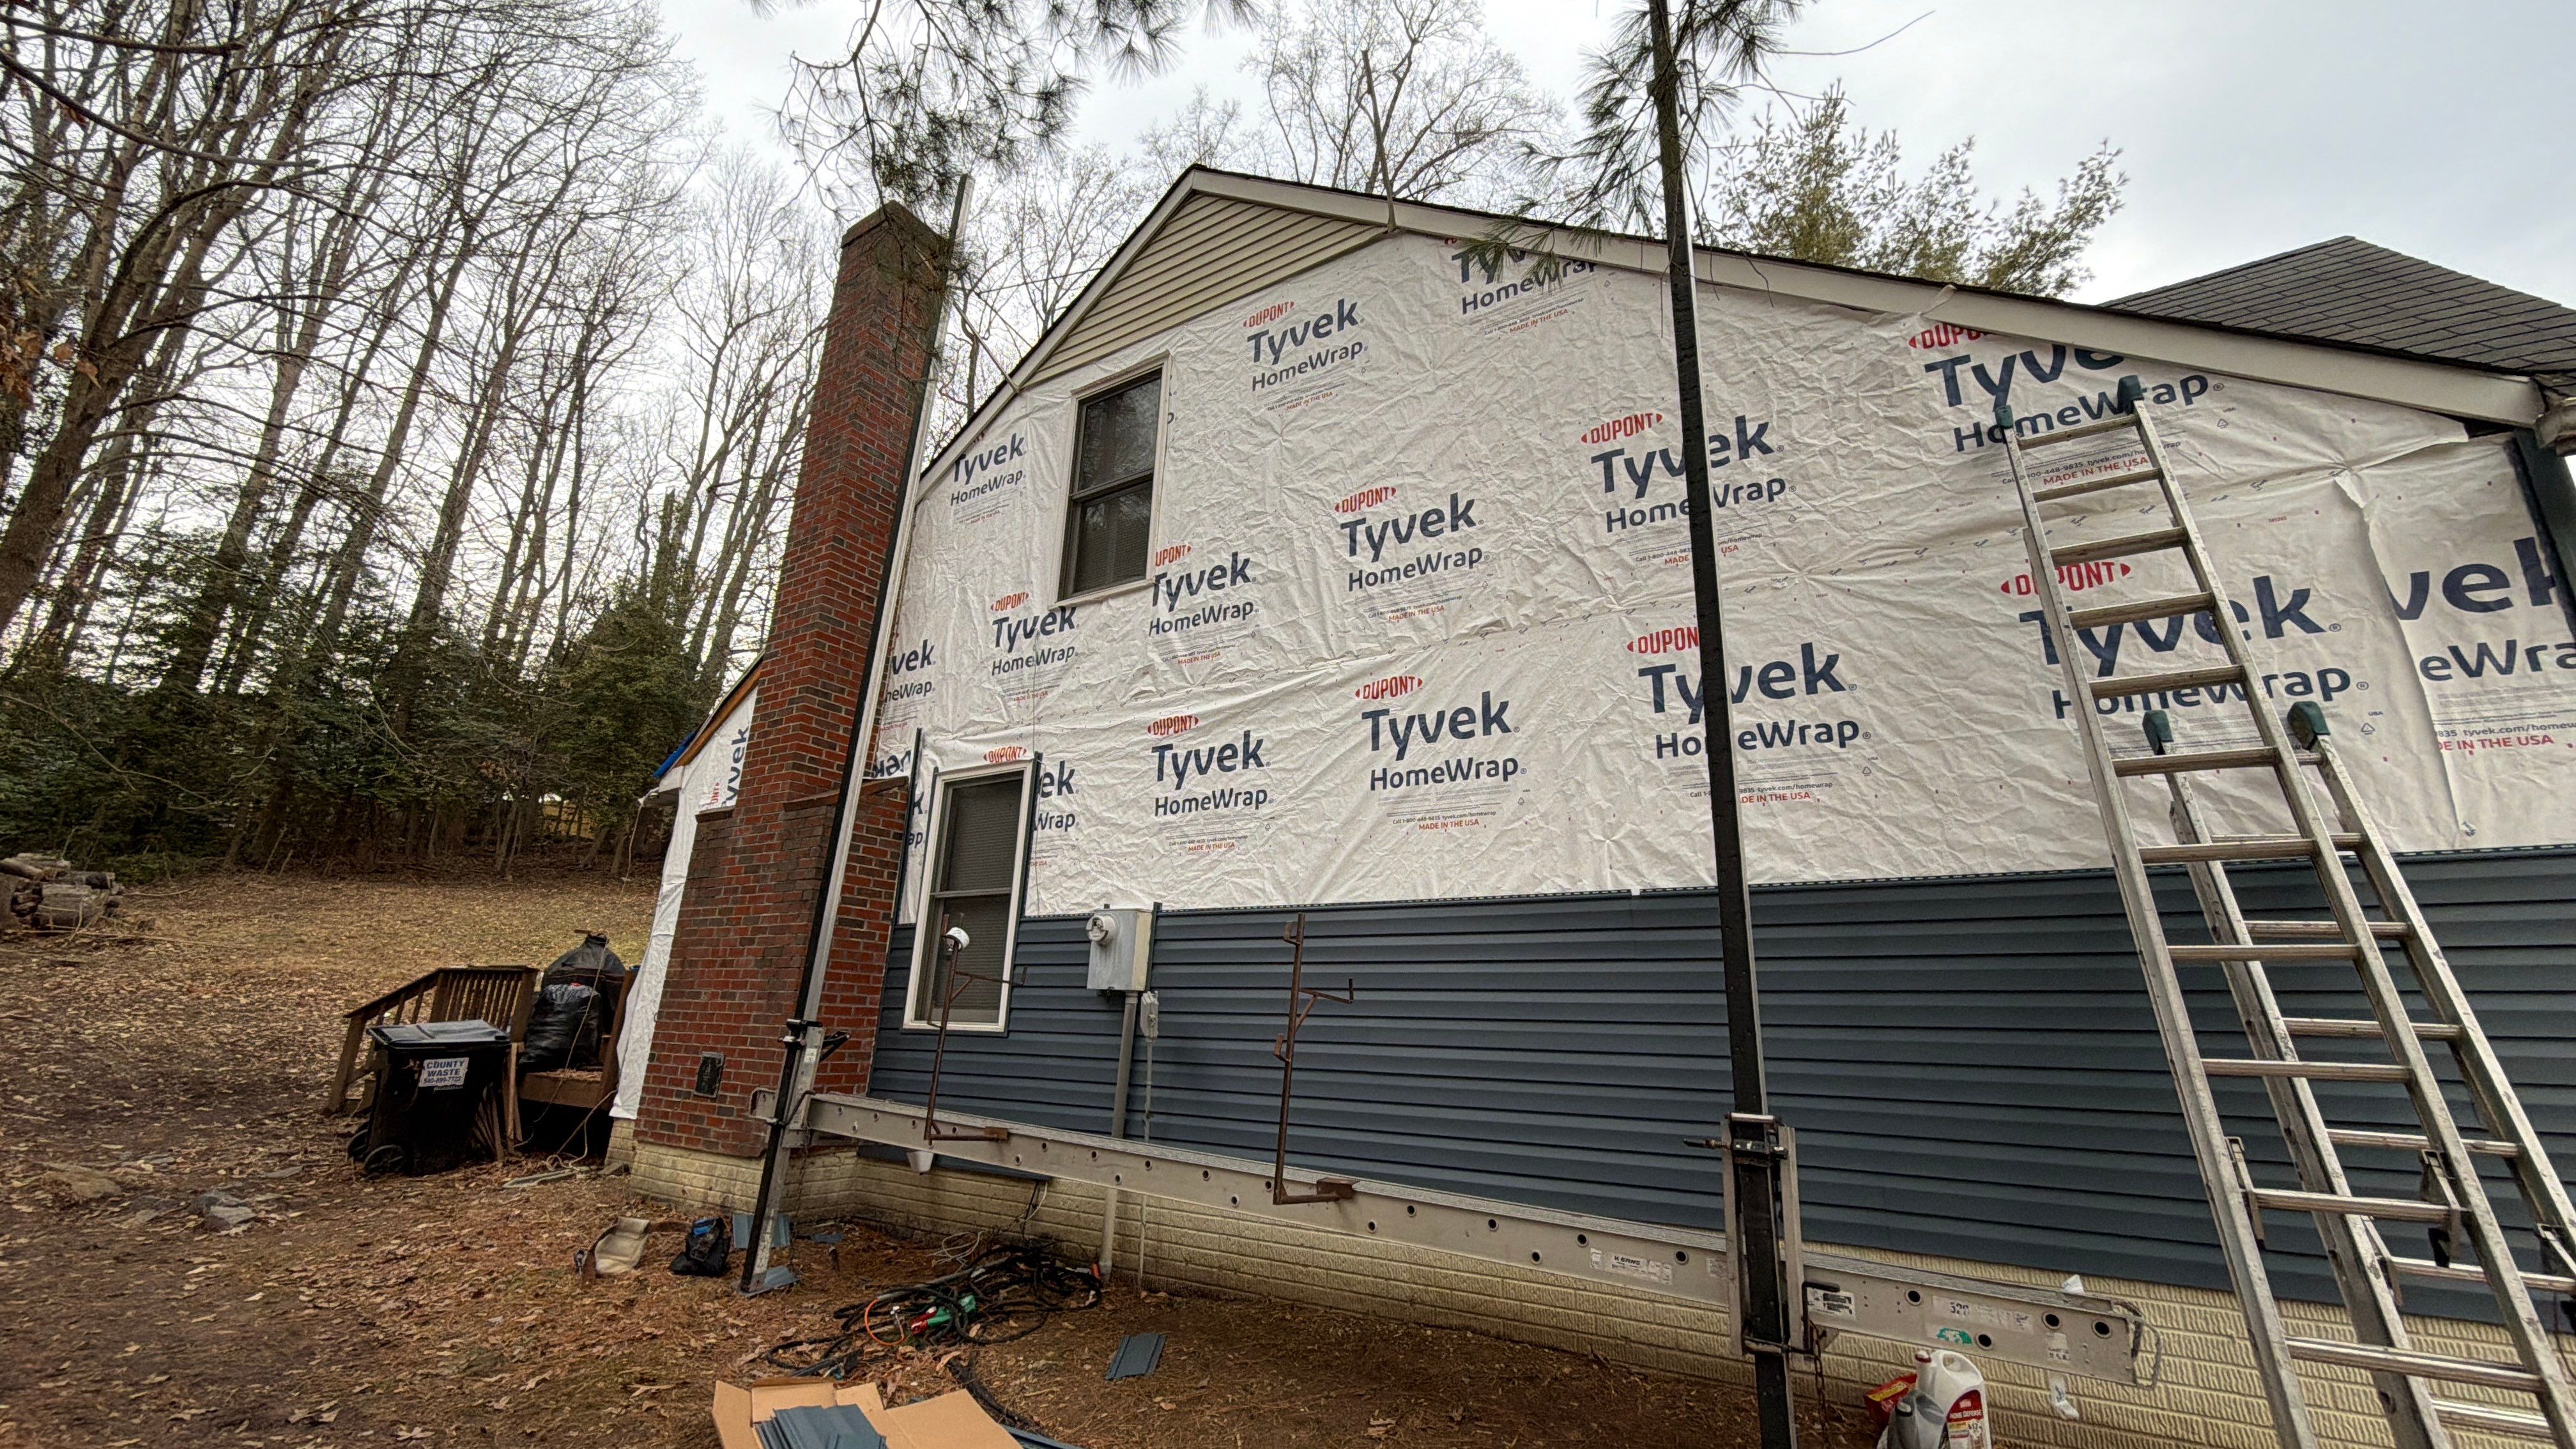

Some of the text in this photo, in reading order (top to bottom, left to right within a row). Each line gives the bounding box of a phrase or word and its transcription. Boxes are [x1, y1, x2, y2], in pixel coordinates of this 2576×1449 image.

[1248, 302, 1289, 328] DUPONT
[1510, 322, 1529, 334] MADE
[1540, 314, 1552, 323] THE
[1554, 309, 1568, 318] USA
[1247, 298, 1359, 365] Tyvek
[1252, 341, 1363, 392] HomeWrap
[1591, 413, 1653, 444] DUPONT
[954, 433, 1024, 485] Tyvek
[1591, 415, 1775, 499] Tyvek
[2044, 456, 2149, 485] MADE IN THE USA
[950, 470, 1023, 506] HomeWrap
[1342, 487, 1390, 514] DUPONT
[1340, 492, 1476, 563] Tyvek
[1155, 544, 1187, 567] UPONT
[1664, 544, 1739, 565] MADE USA
[1152, 551, 1251, 613] Tyvek
[1348, 548, 1482, 592] HomeWrap
[994, 592, 1026, 611] DUPONT
[1388, 613, 1407, 622] MADE
[1431, 605, 1445, 613] USA
[992, 606, 1077, 653] Tyvek
[1149, 601, 1254, 637] HomeWrap
[1637, 626, 1699, 654] DUPON
[992, 646, 1075, 676] HomeWrap
[1363, 676, 1416, 700] DUPONT
[1153, 715, 1193, 735] DUPONT
[1361, 691, 1512, 761] Tyvek
[1656, 720, 1859, 758] HoeWrap
[2463, 721, 2576, 736] tyvek.com/homew
[988, 746, 1023, 764] DUPONT
[2457, 739, 2474, 750] IN
[2477, 737, 2513, 749] THE
[2517, 734, 2555, 746] USA
[1151, 730, 1264, 790] Tyvek
[1370, 757, 1519, 791] HomeWrap
[1757, 794, 1767, 802] IN
[1769, 793, 1788, 802] THE
[1791, 792, 1811, 801] USA
[1758, 781, 1833, 793] tyvek.com/homewrap
[1154, 788, 1268, 817] HomeWrap
[1418, 822, 1439, 831] MADE
[426, 1060, 464, 1069] COUNTY
